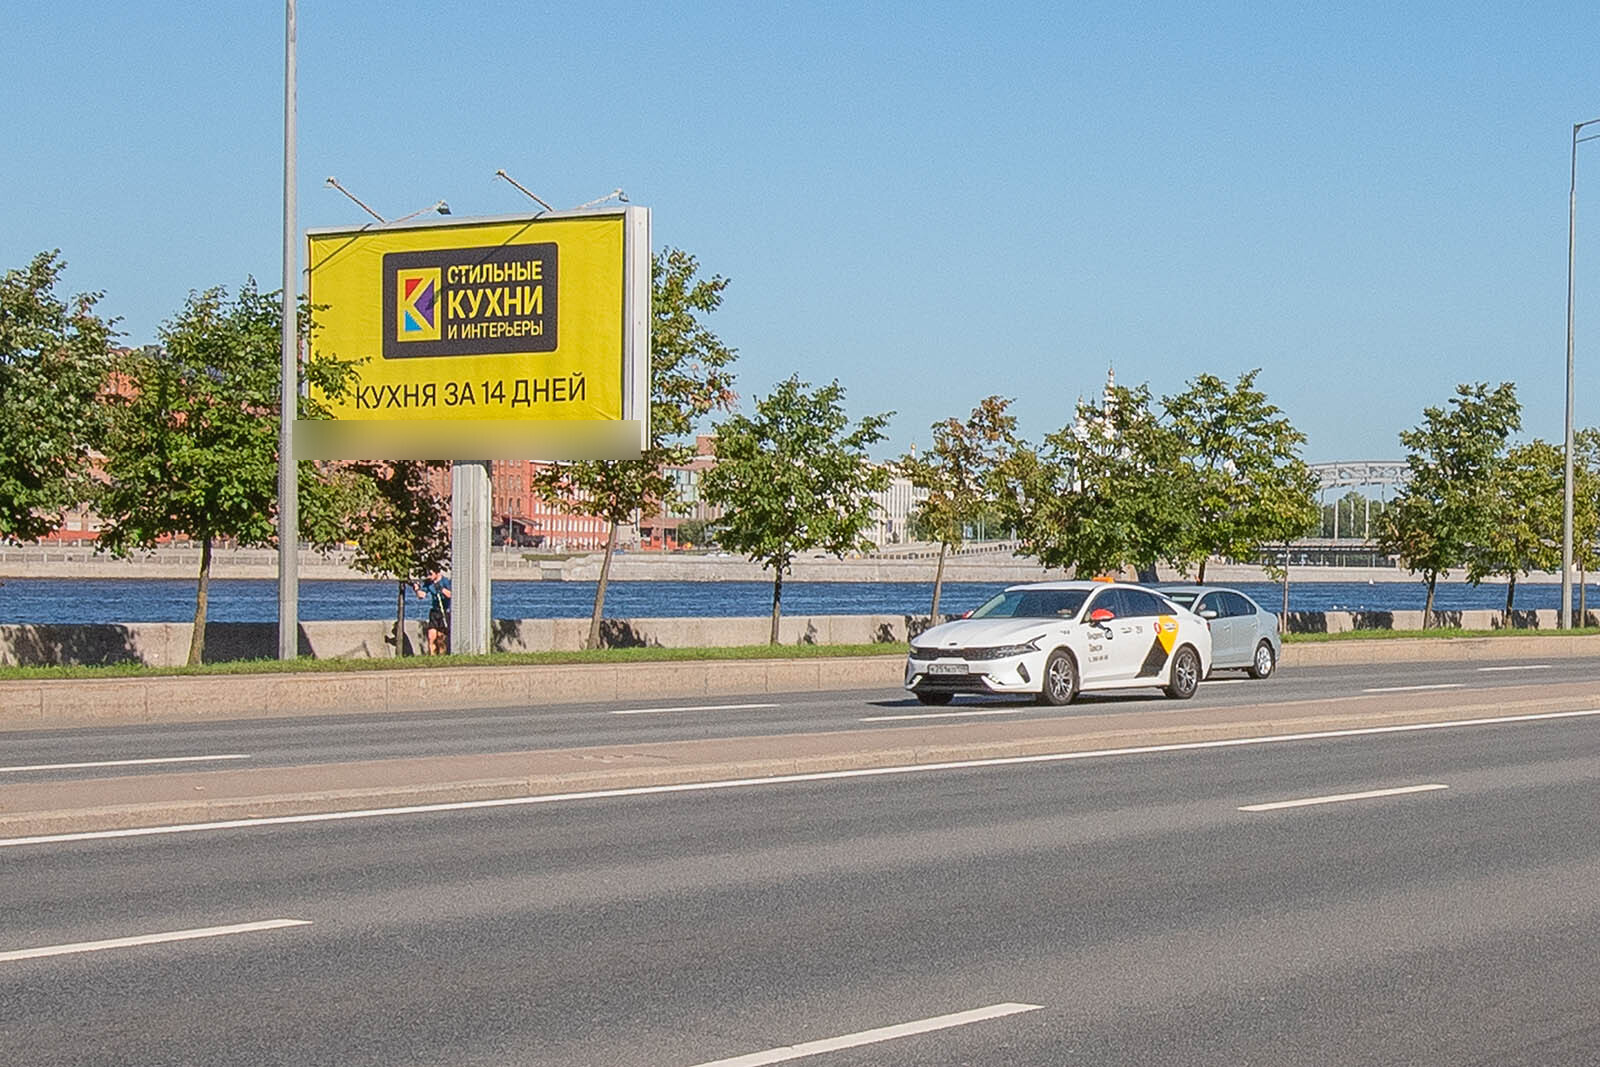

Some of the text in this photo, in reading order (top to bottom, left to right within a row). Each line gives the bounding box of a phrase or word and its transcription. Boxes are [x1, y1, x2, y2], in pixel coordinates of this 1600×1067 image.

[447, 260, 543, 284] СТИЛЬНЫЕ
[447, 285, 543, 319] КУХНИ
[447, 319, 543, 340] И ИНТЕРЬЕРЫ
[356, 372, 586, 409] КУХНЯ ЗА 14 ДНЕЙ
